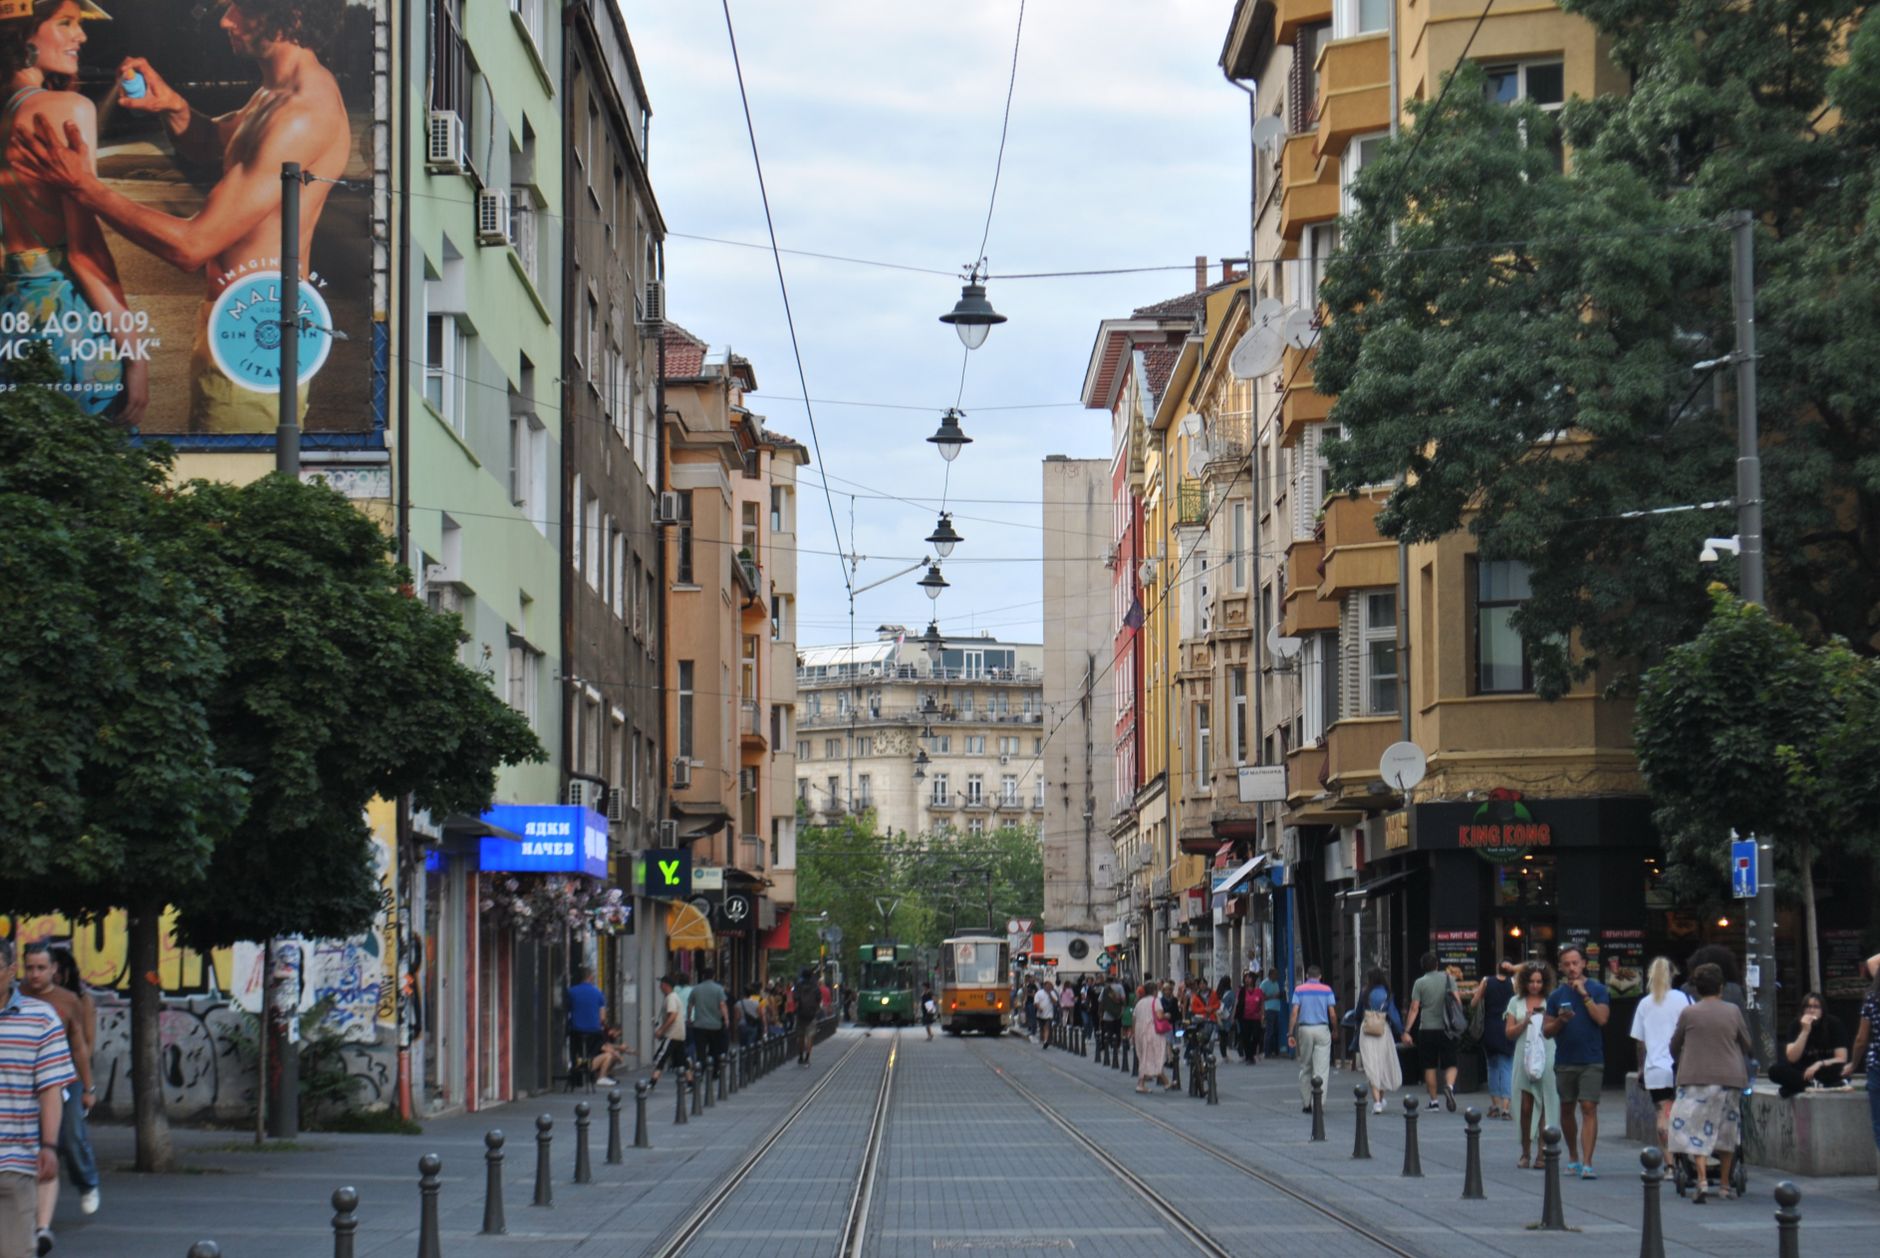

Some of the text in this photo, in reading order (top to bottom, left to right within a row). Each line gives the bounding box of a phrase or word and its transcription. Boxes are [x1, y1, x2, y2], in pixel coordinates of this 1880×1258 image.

[308, 271, 328, 288] BY
[227, 284, 313, 320] MALY
[41, 311, 82, 337] ДО
[88, 311, 155, 333] 01.09.
[221, 331, 246, 339] GIN
[60, 338, 160, 364] „ЮНАК“
[39, 383, 124, 393] тговорно
[525, 822, 570, 836] ЯДКИ
[1458, 823, 1551, 847] KING KONG
[521, 842, 574, 855] НАЧЕВ
